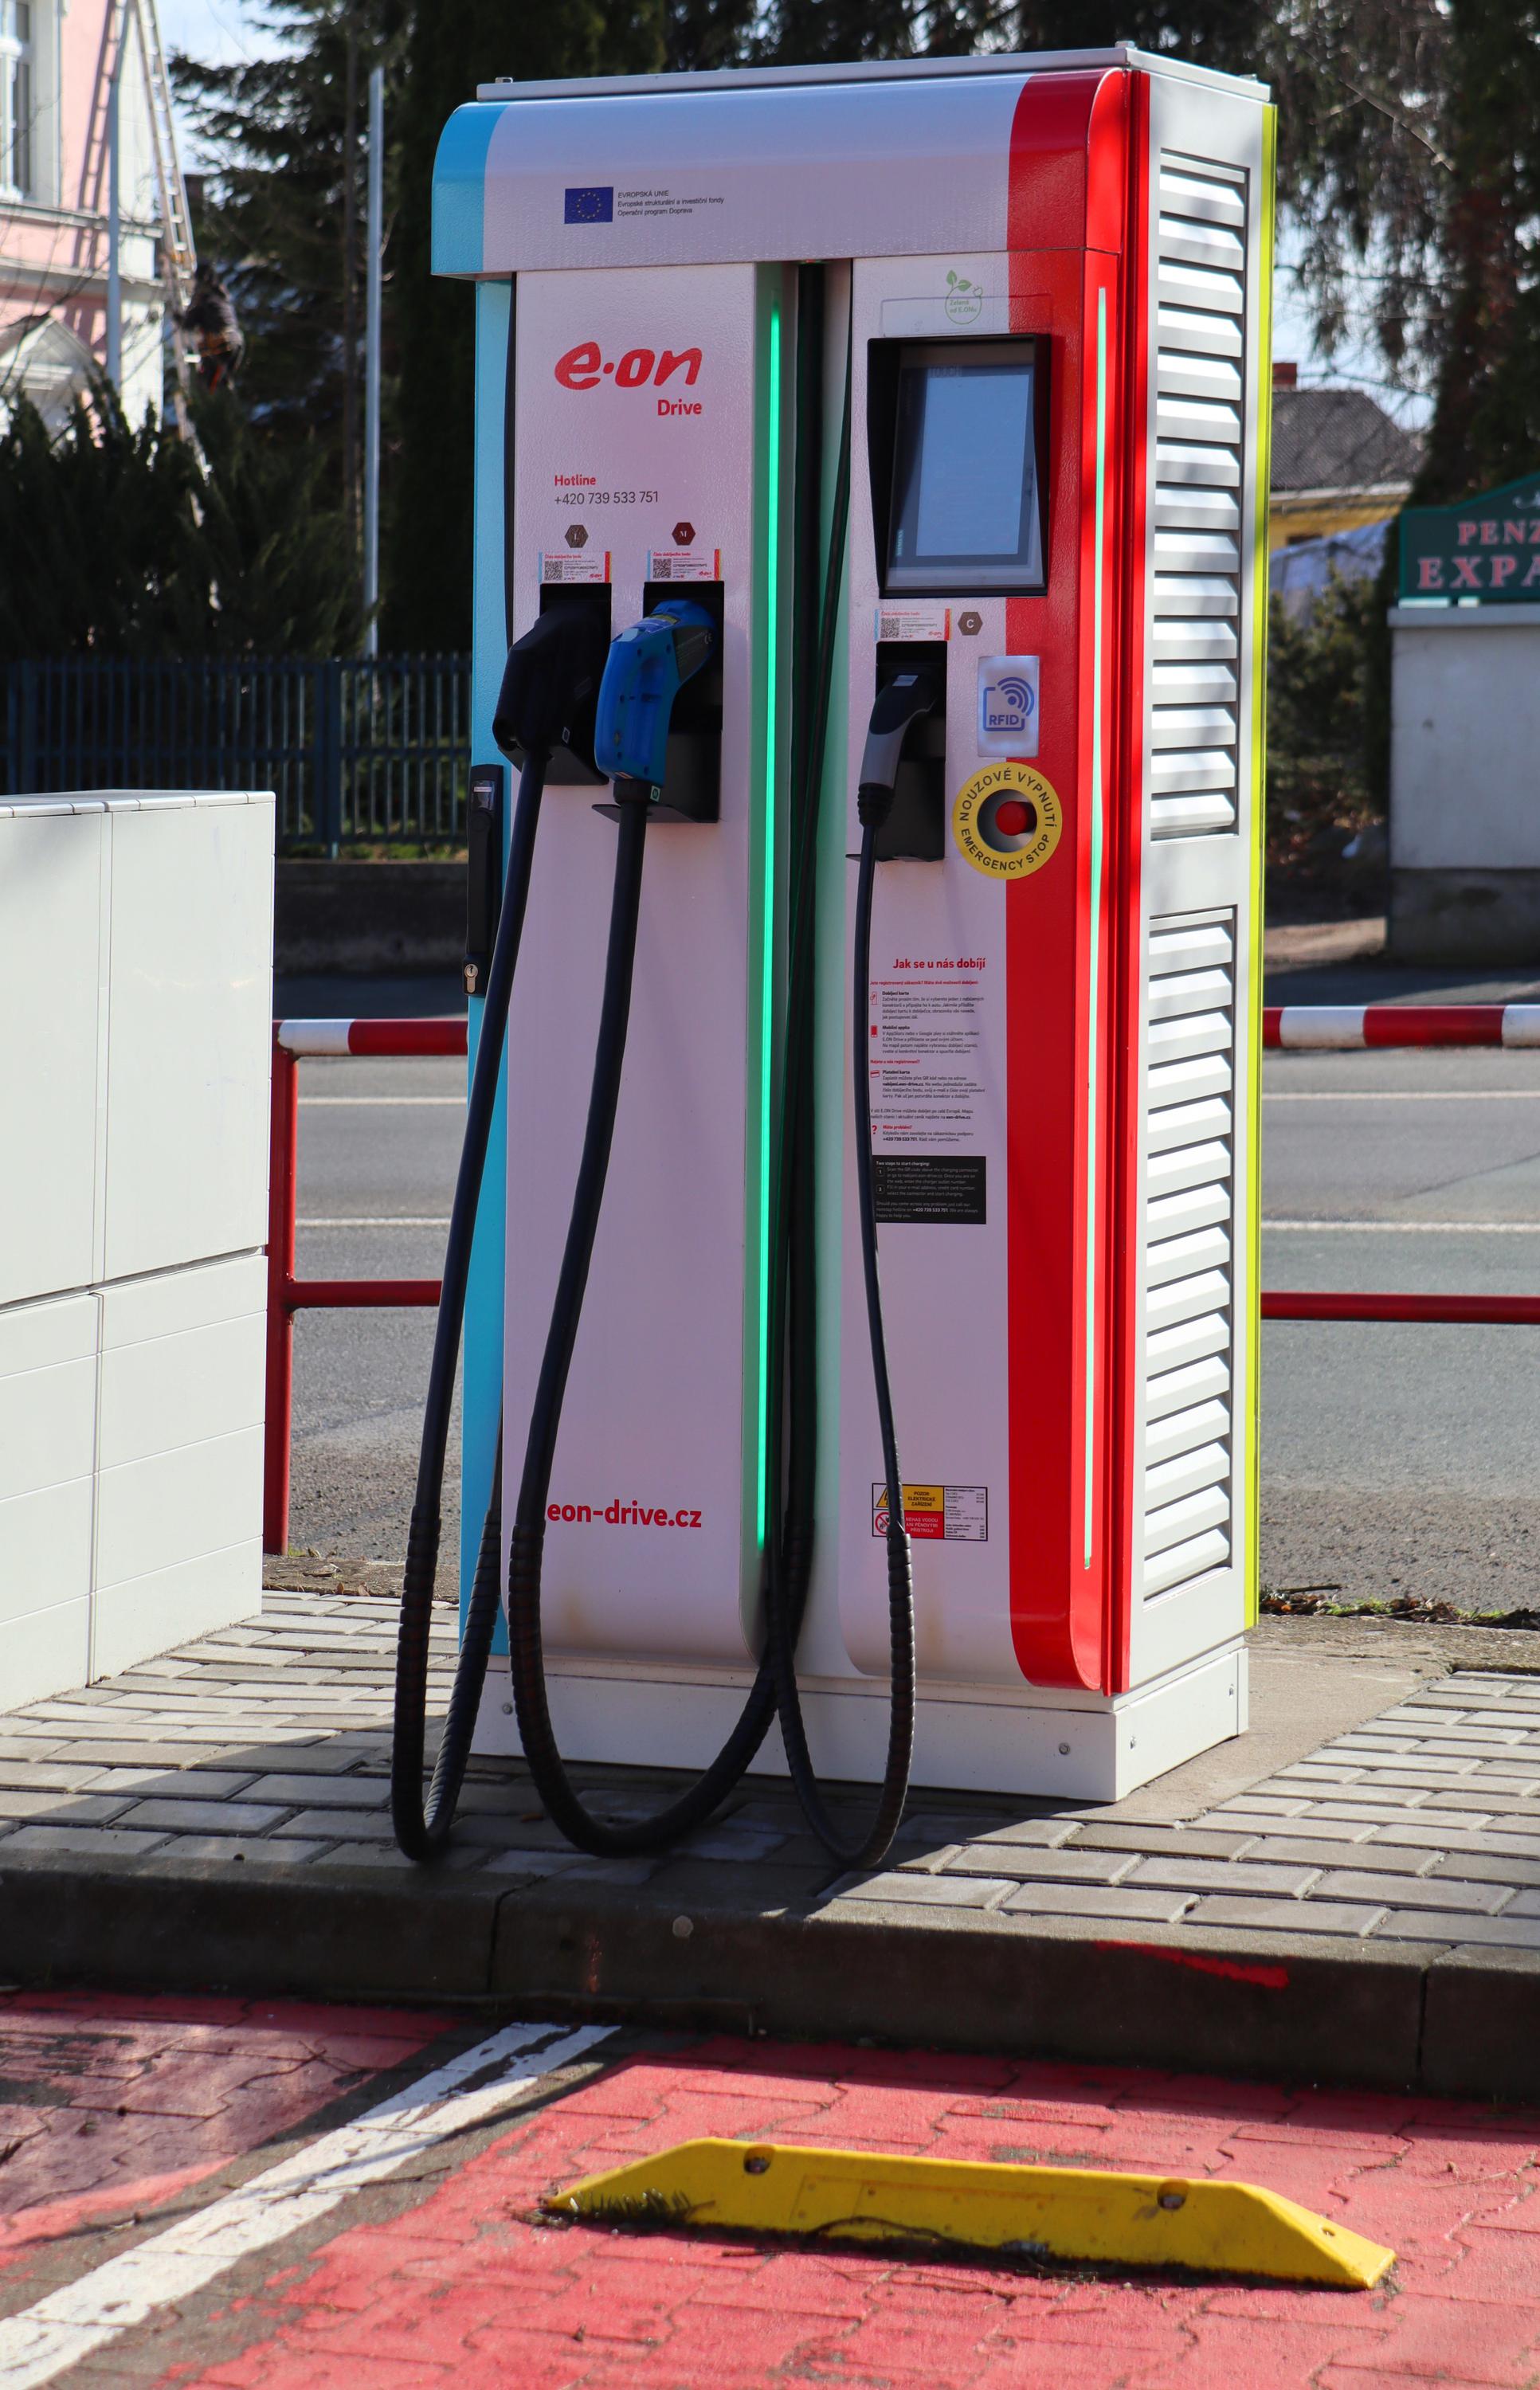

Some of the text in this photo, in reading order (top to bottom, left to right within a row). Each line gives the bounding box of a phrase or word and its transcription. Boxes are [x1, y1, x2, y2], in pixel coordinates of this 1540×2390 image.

[657, 398, 703, 416] Drive
[554, 475, 596, 486] Hotline
[554, 491, 659, 505] +420 739 533 751
[966, 619, 974, 629] C
[989, 715, 1019, 725] RFID
[960, 768, 1057, 828] NOUZOVÉ VYPNUTÍ
[961, 829, 1050, 870] EMERGENCY STOP
[893, 958, 911, 969] Jak
[936, 958, 954, 968] nás
[957, 958, 986, 971] dobíjí
[547, 1499, 702, 1528] eon-drive.cz
